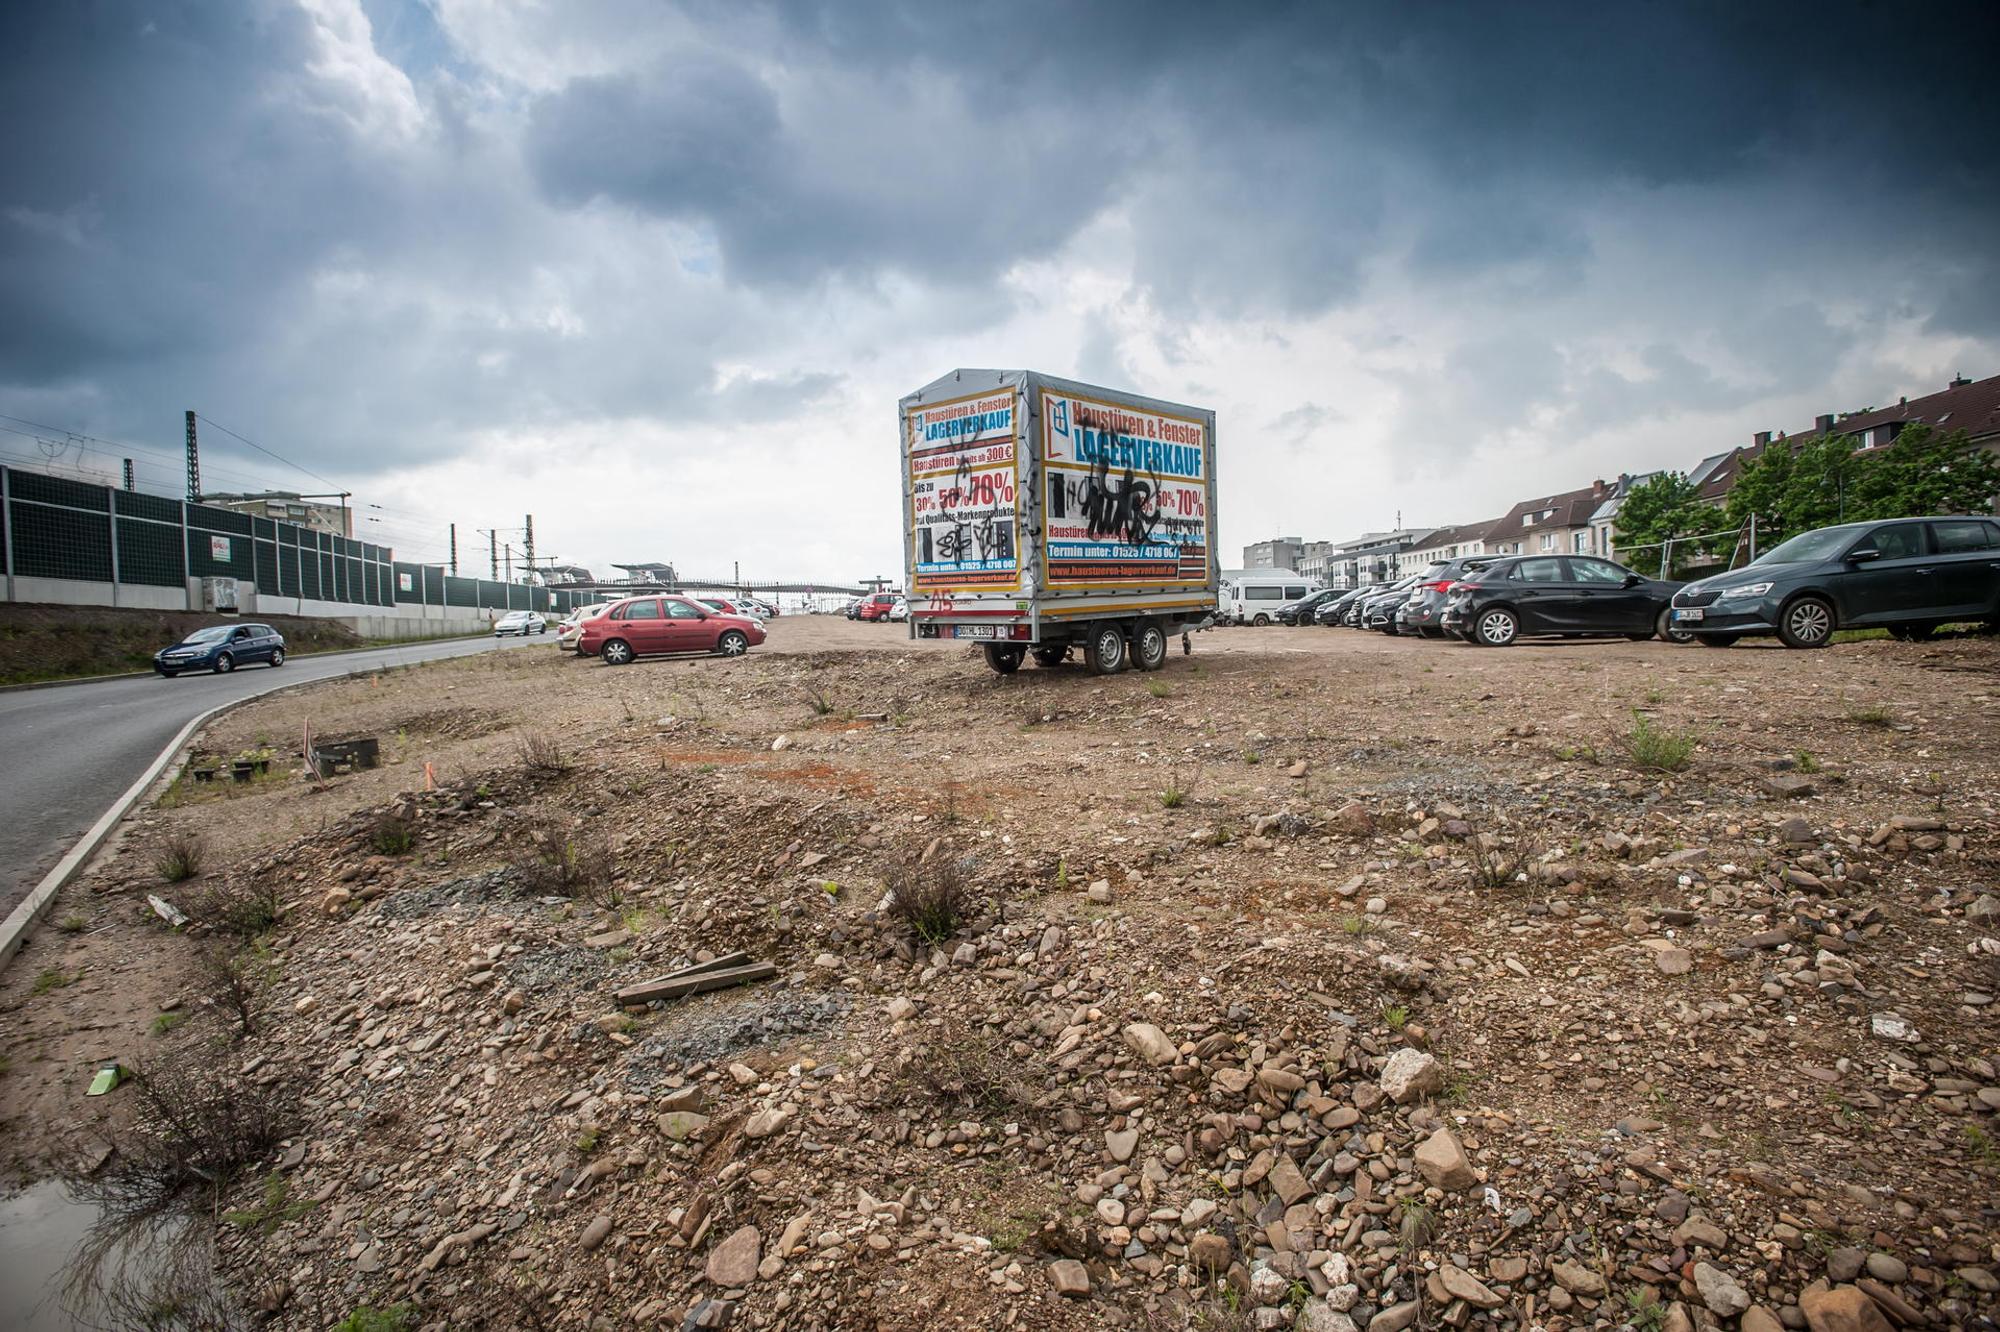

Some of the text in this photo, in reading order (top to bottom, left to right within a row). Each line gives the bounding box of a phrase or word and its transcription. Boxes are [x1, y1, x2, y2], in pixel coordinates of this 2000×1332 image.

[925, 397, 1011, 424] Haustüren & Fenster
[1072, 401, 1201, 446] Haustüren & Fenster
[926, 409, 1011, 441] LAGERVERKAUF
[914, 456, 955, 472] Haustüren
[1074, 428, 1201, 477] LAGERVERKAUF
[916, 471, 1014, 512] 30% 50% 70%
[1156, 489, 1175, 508] 50%
[1177, 489, 1204, 516] 70%
[1049, 523, 1091, 539] Haustüre
[1048, 545, 1082, 557] Termin
[1084, 545, 1111, 558] unter:
[1112, 545, 1138, 558] 01525
[1145, 546, 1161, 558] 4718
[1050, 565, 1176, 577] www.haustueren-lagerverkauf.de
